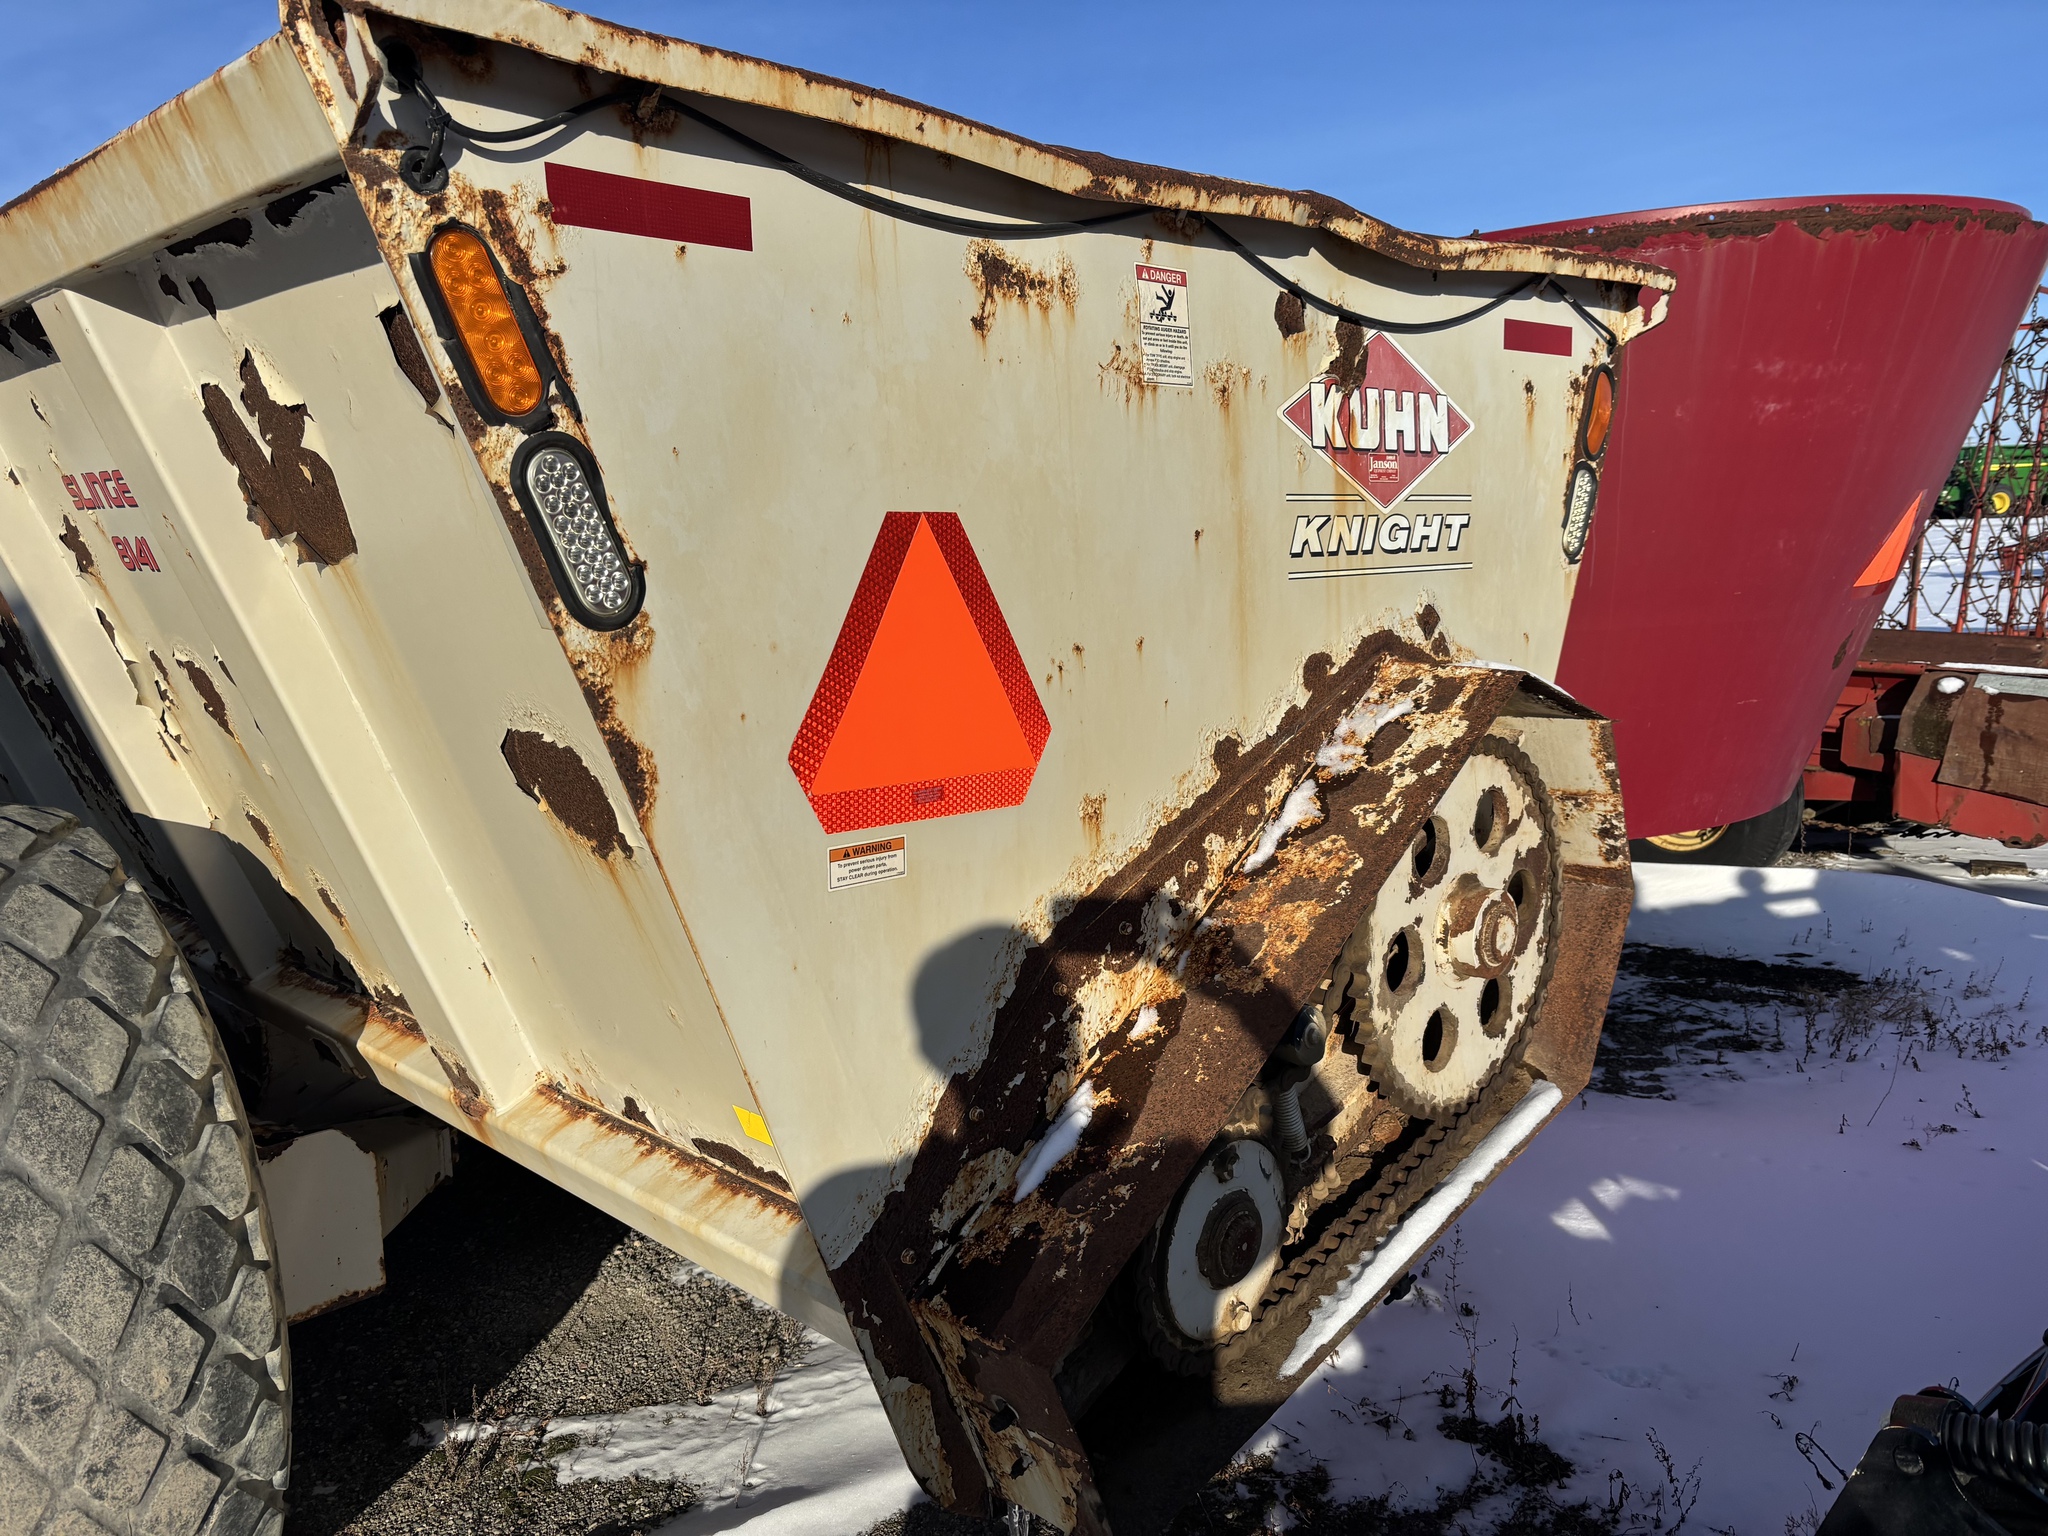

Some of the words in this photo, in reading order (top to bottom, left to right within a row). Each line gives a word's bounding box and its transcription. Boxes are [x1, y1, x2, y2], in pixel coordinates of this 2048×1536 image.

[1150, 270, 1182, 284] DANGER
[1309, 382, 1450, 454] KUHN
[1370, 456, 1398, 472] Janson
[1289, 513, 1471, 558] KNIGHT
[852, 841, 892, 856] WARNING
